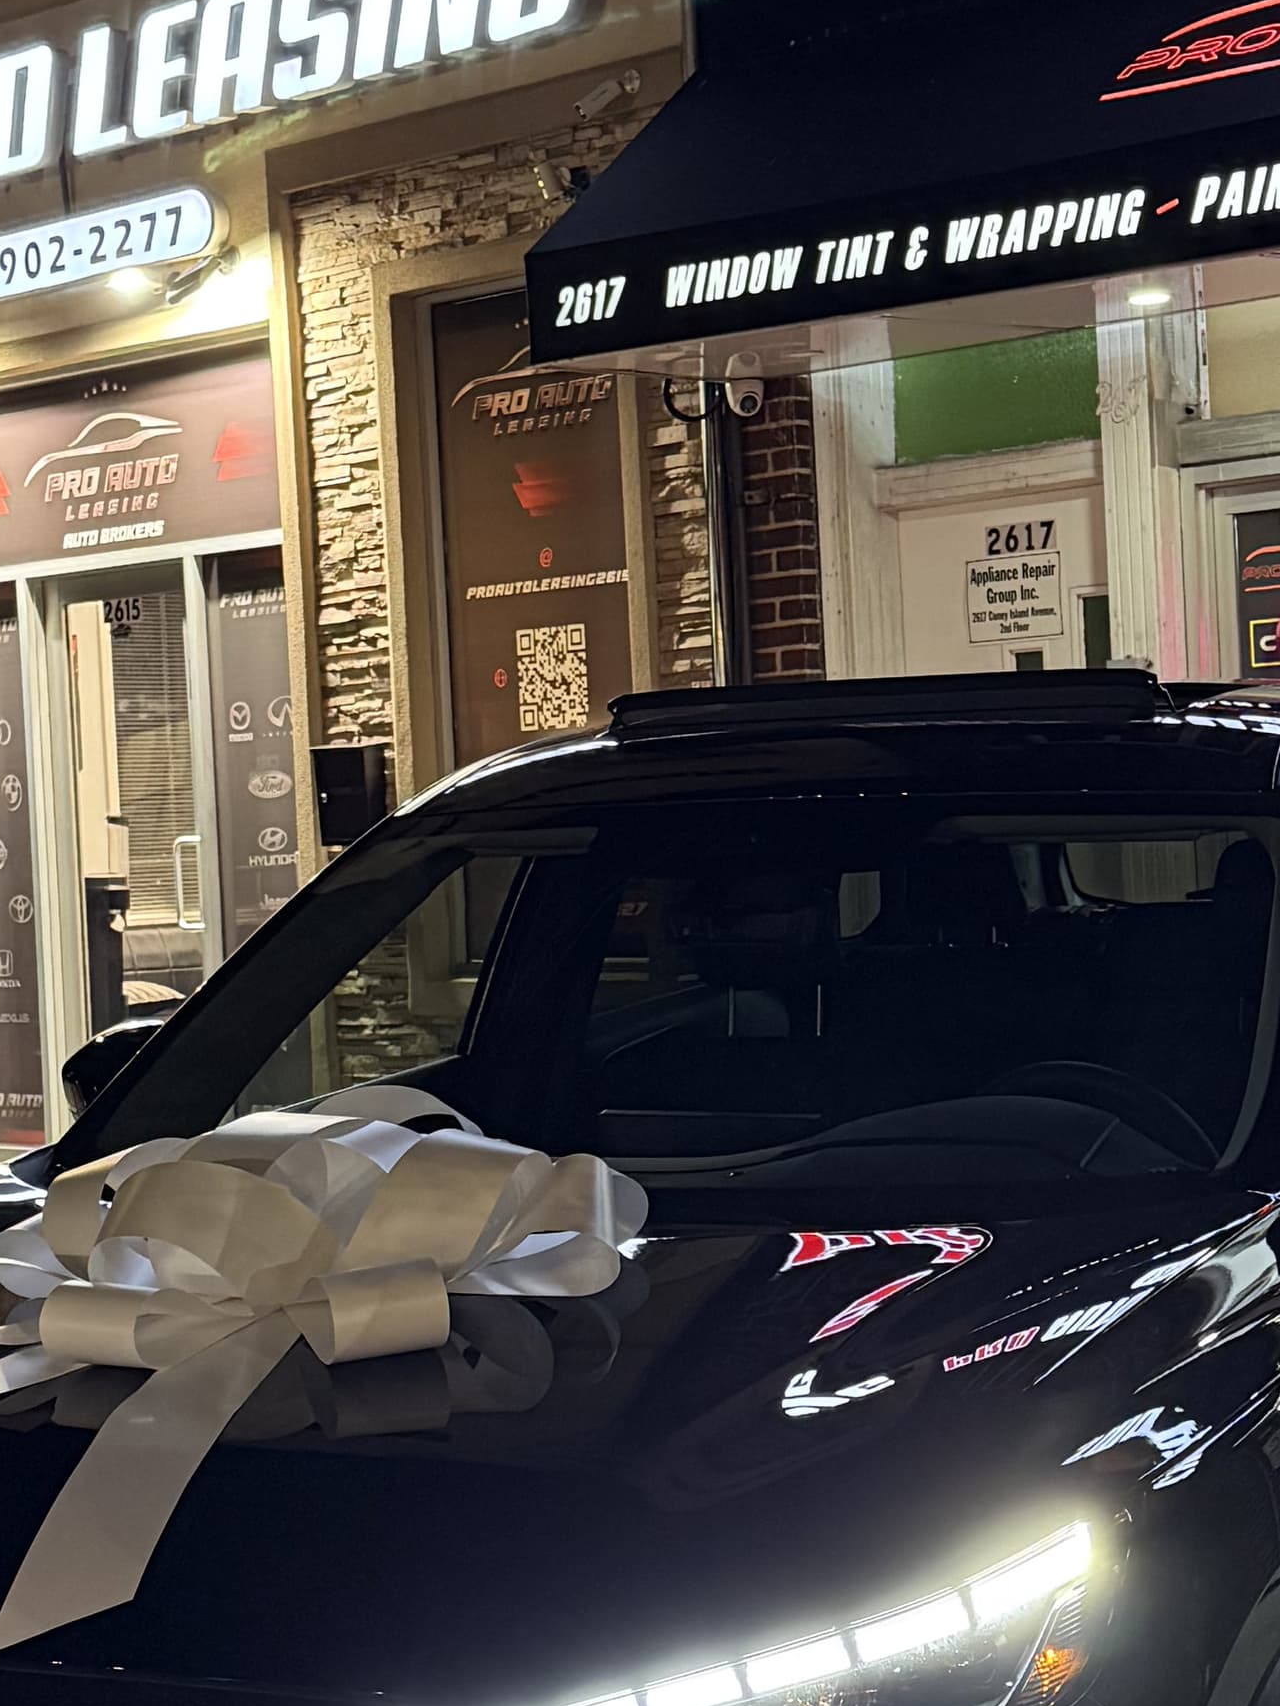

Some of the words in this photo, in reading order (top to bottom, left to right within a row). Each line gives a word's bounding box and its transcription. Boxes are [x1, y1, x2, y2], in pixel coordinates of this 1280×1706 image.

[557, 276, 626, 327] 2617
[666, 247, 802, 308] WINDOW
[815, 232, 889, 285] TINT
[906, 226, 928, 271] &
[944, 189, 1147, 264] WRAPPING
[472, 388, 531, 421] PRO
[535, 374, 614, 409] AUTO
[493, 408, 592, 436] LEASING
[44, 467, 100, 502] PRO
[104, 454, 179, 493] AUTO
[65, 492, 159, 522] LEASING
[63, 529, 99, 549] AUTO
[100, 520, 164, 544] BROKERS
[987, 520, 1055, 555] 2617
[970, 566, 1018, 587] Appliance
[1022, 559, 1056, 581] Repair
[986, 588, 1017, 605] Group
[1020, 585, 1040, 601] Inc.
[104, 598, 140, 624] 2615
[1010, 607, 1029, 619] Island
[1000, 623, 1012, 633] 2nd
[1013, 622, 1030, 632] Floor
